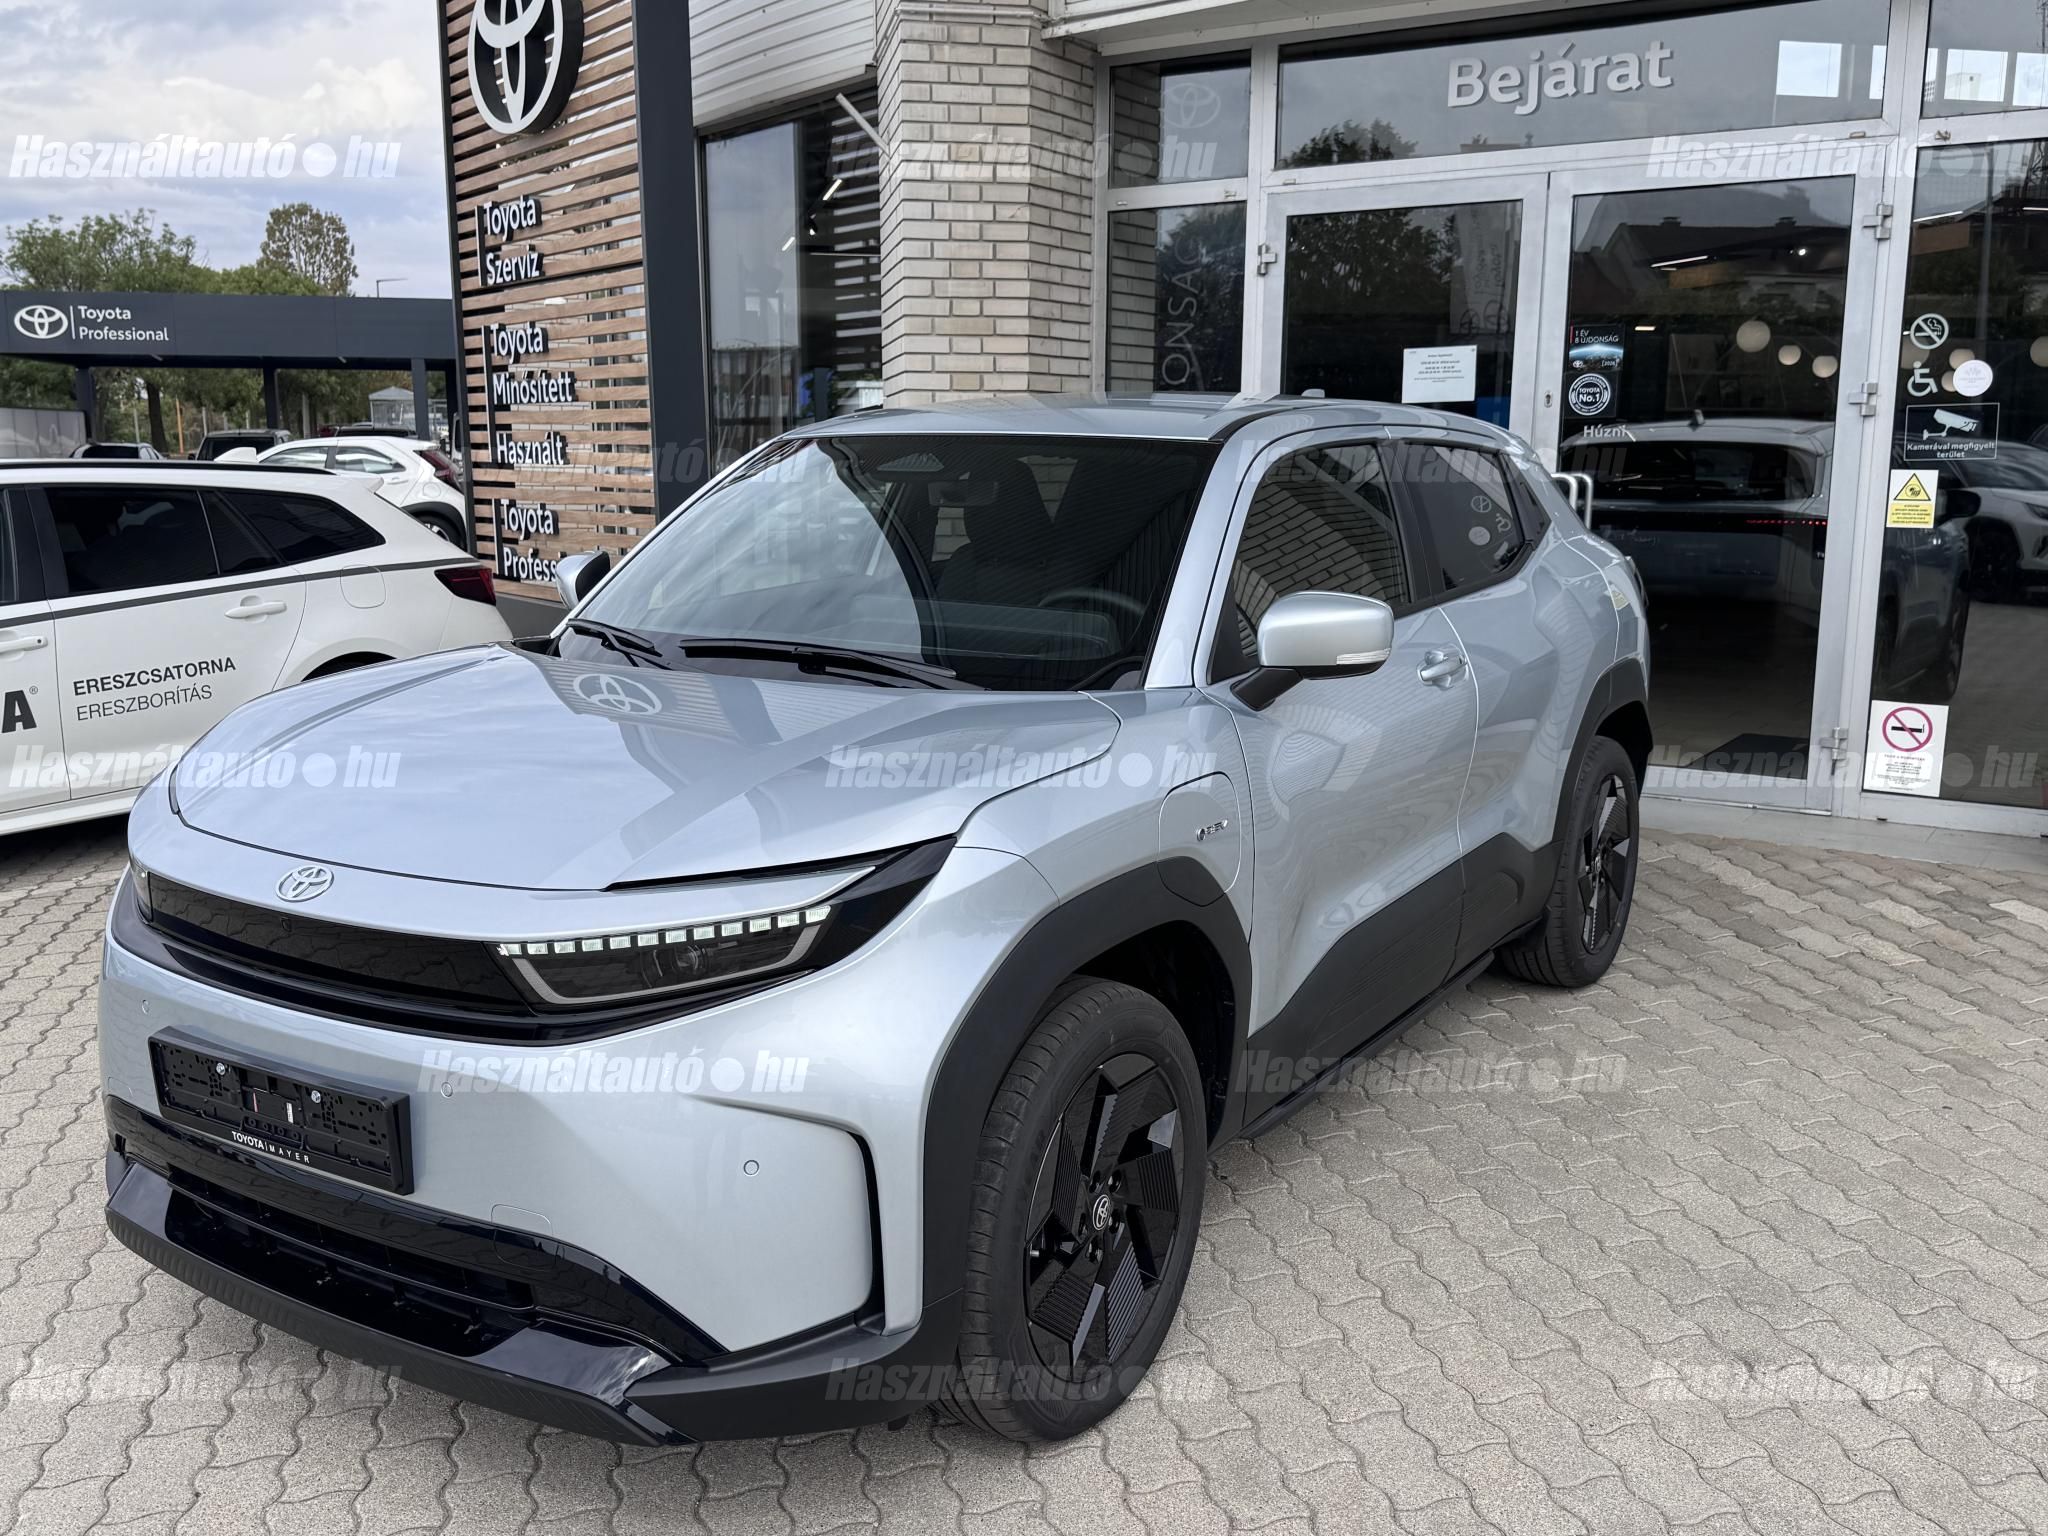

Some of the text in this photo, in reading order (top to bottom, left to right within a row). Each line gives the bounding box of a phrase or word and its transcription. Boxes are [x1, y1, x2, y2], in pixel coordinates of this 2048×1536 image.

[1447, 40, 1674, 115] Bejárat
[483, 194, 537, 241] Toyota
[486, 244, 540, 286] Szerviz
[78, 305, 132, 322] Toyota
[79, 325, 169, 341] Professional
[490, 321, 544, 364] Toyota
[492, 370, 573, 405] Minősített
[1579, 393, 1600, 402] No.1
[496, 431, 565, 465] Használt
[1583, 424, 1626, 438] Húzni
[1906, 441, 1996, 451] Kamerával megfigyelt
[500, 499, 554, 541] Toyota
[503, 547, 560, 582] Profess
[72, 656, 237, 696] ERESZCSATORNA
[76, 684, 213, 722] ERESZBORÍTÁS
[231, 1131, 310, 1164] TOYOTA MAYER
